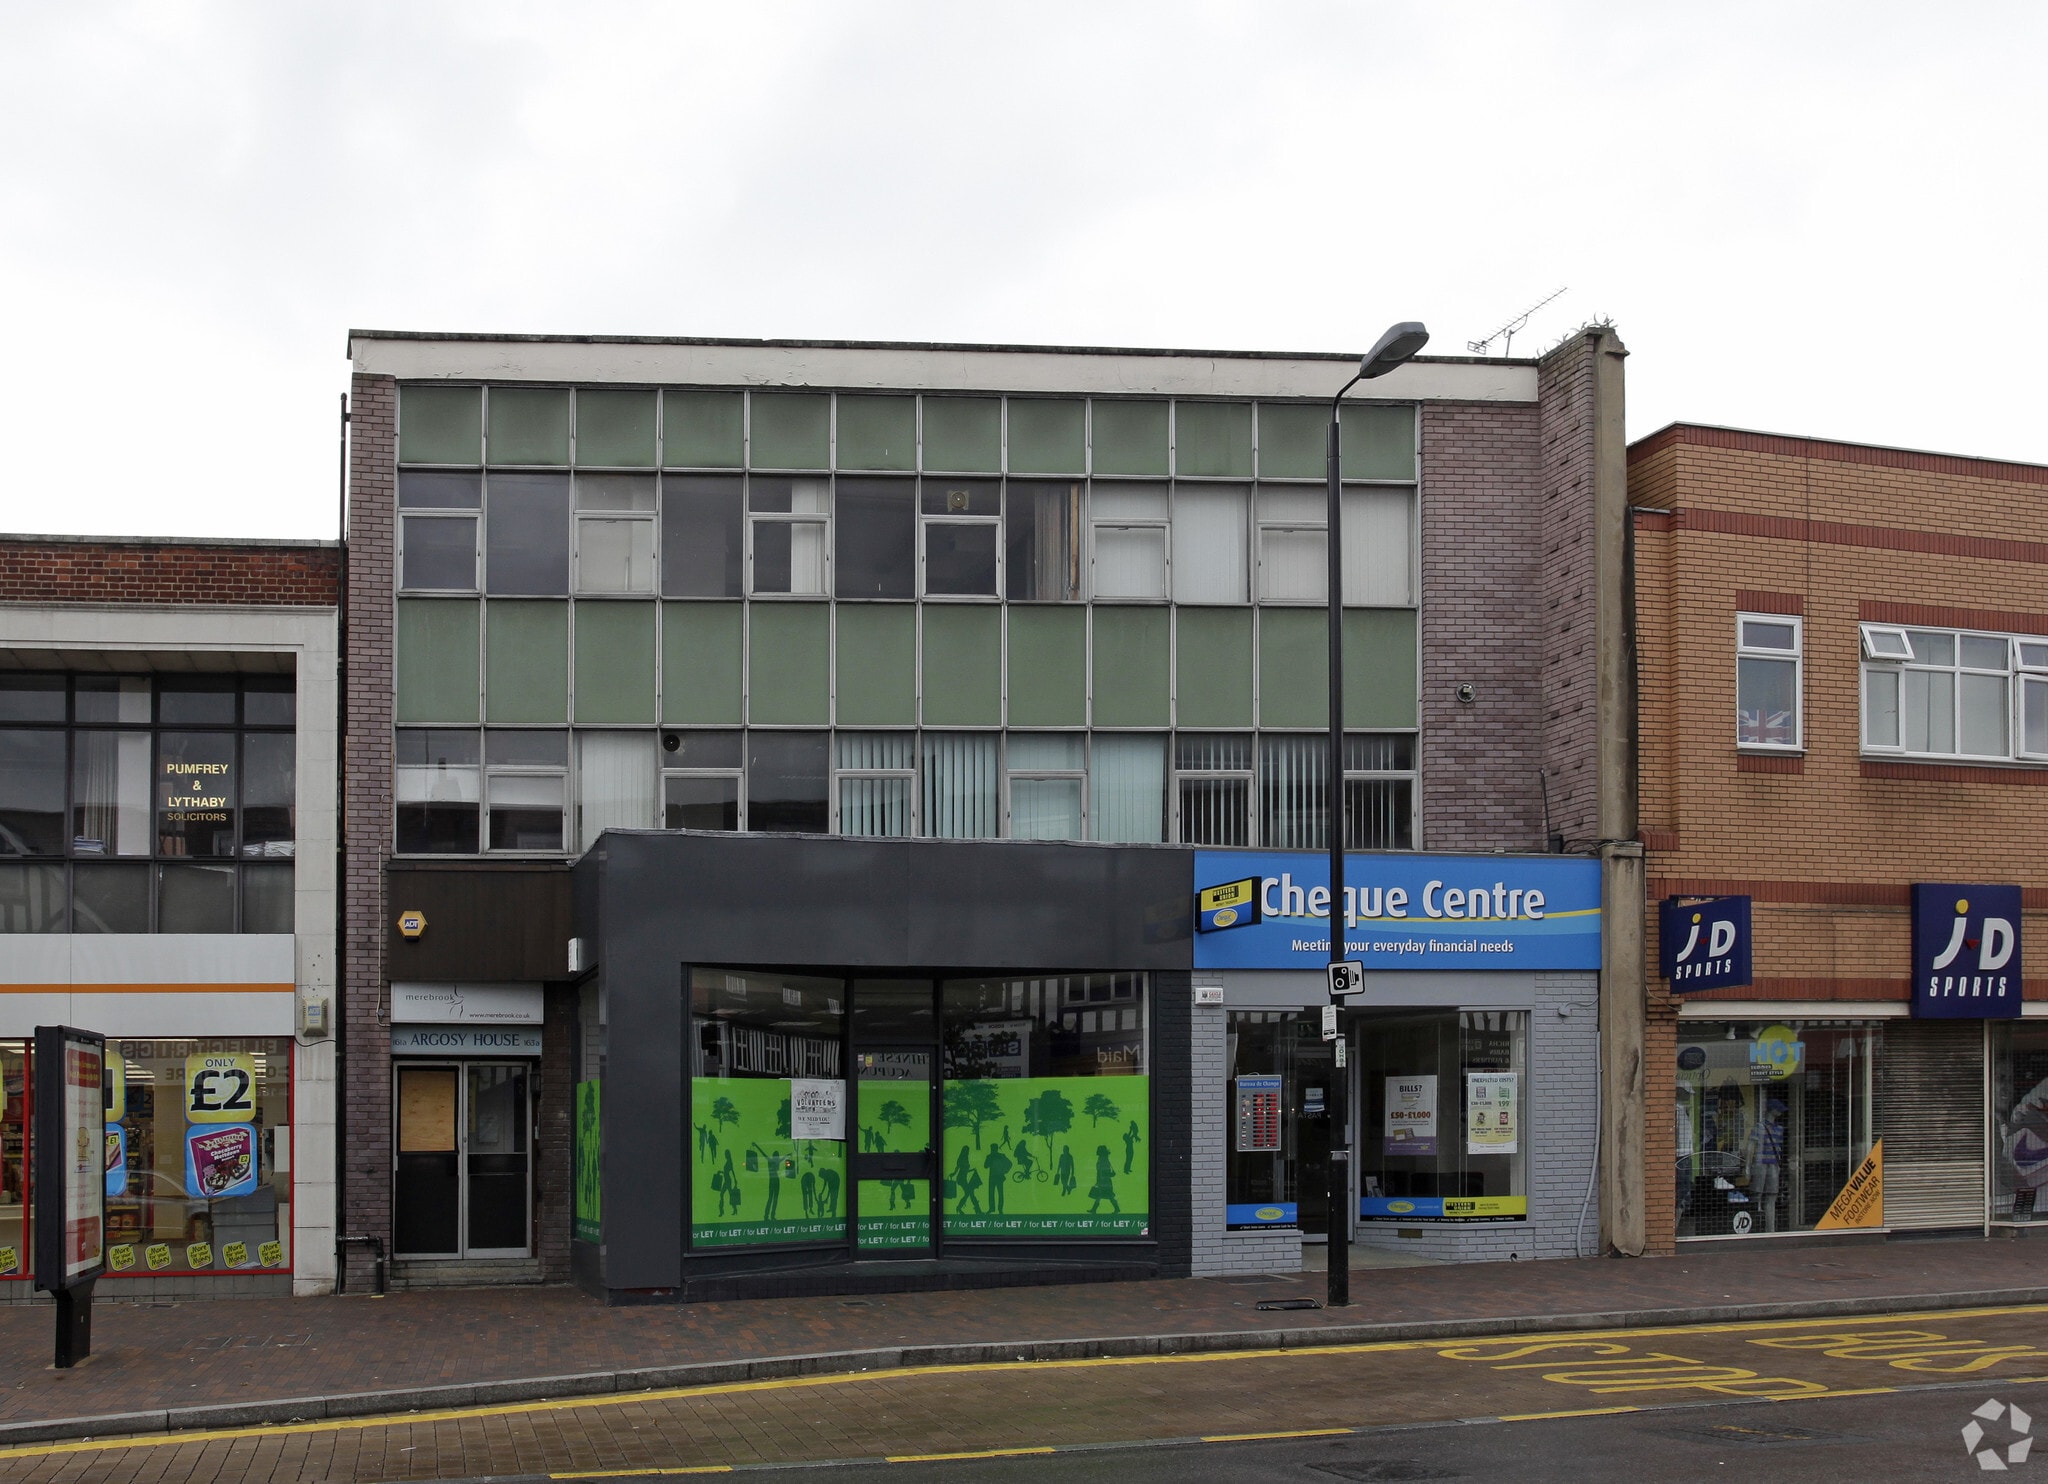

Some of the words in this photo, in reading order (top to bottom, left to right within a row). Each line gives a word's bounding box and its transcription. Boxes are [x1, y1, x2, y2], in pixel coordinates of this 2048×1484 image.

[166, 764, 228, 774] PUMFREY
[192, 780, 202, 790] &
[168, 796, 226, 807] LYTHABY
[167, 812, 227, 821] SOLICITORS
[1262, 873, 1408, 928] Cheque
[1423, 880, 1544, 919] Centre
[1292, 939, 1331, 951] Meetin
[1344, 942, 1369, 954] your
[1373, 940, 1426, 954] everyday
[1430, 940, 1477, 952] financial
[1481, 940, 1514, 952] needs
[1675, 959, 1731, 980] SPORTS
[1930, 976, 2007, 997] SPORTS
[411, 1033, 467, 1046] ARGOSY
[473, 1033, 520, 1046] HOUSE
[1749, 1040, 1804, 1064] HOT
[205, 1058, 235, 1068] ONLY
[190, 1068, 252, 1112] £2
[1830, 1189, 1855, 1220] MEGA
[1850, 1158, 1876, 1191] VALUE
[1843, 1176, 1880, 1225] FOOTWEAR
[1744, 1330, 2048, 1372] BUS
[1436, 1342, 1828, 1396] STOP
